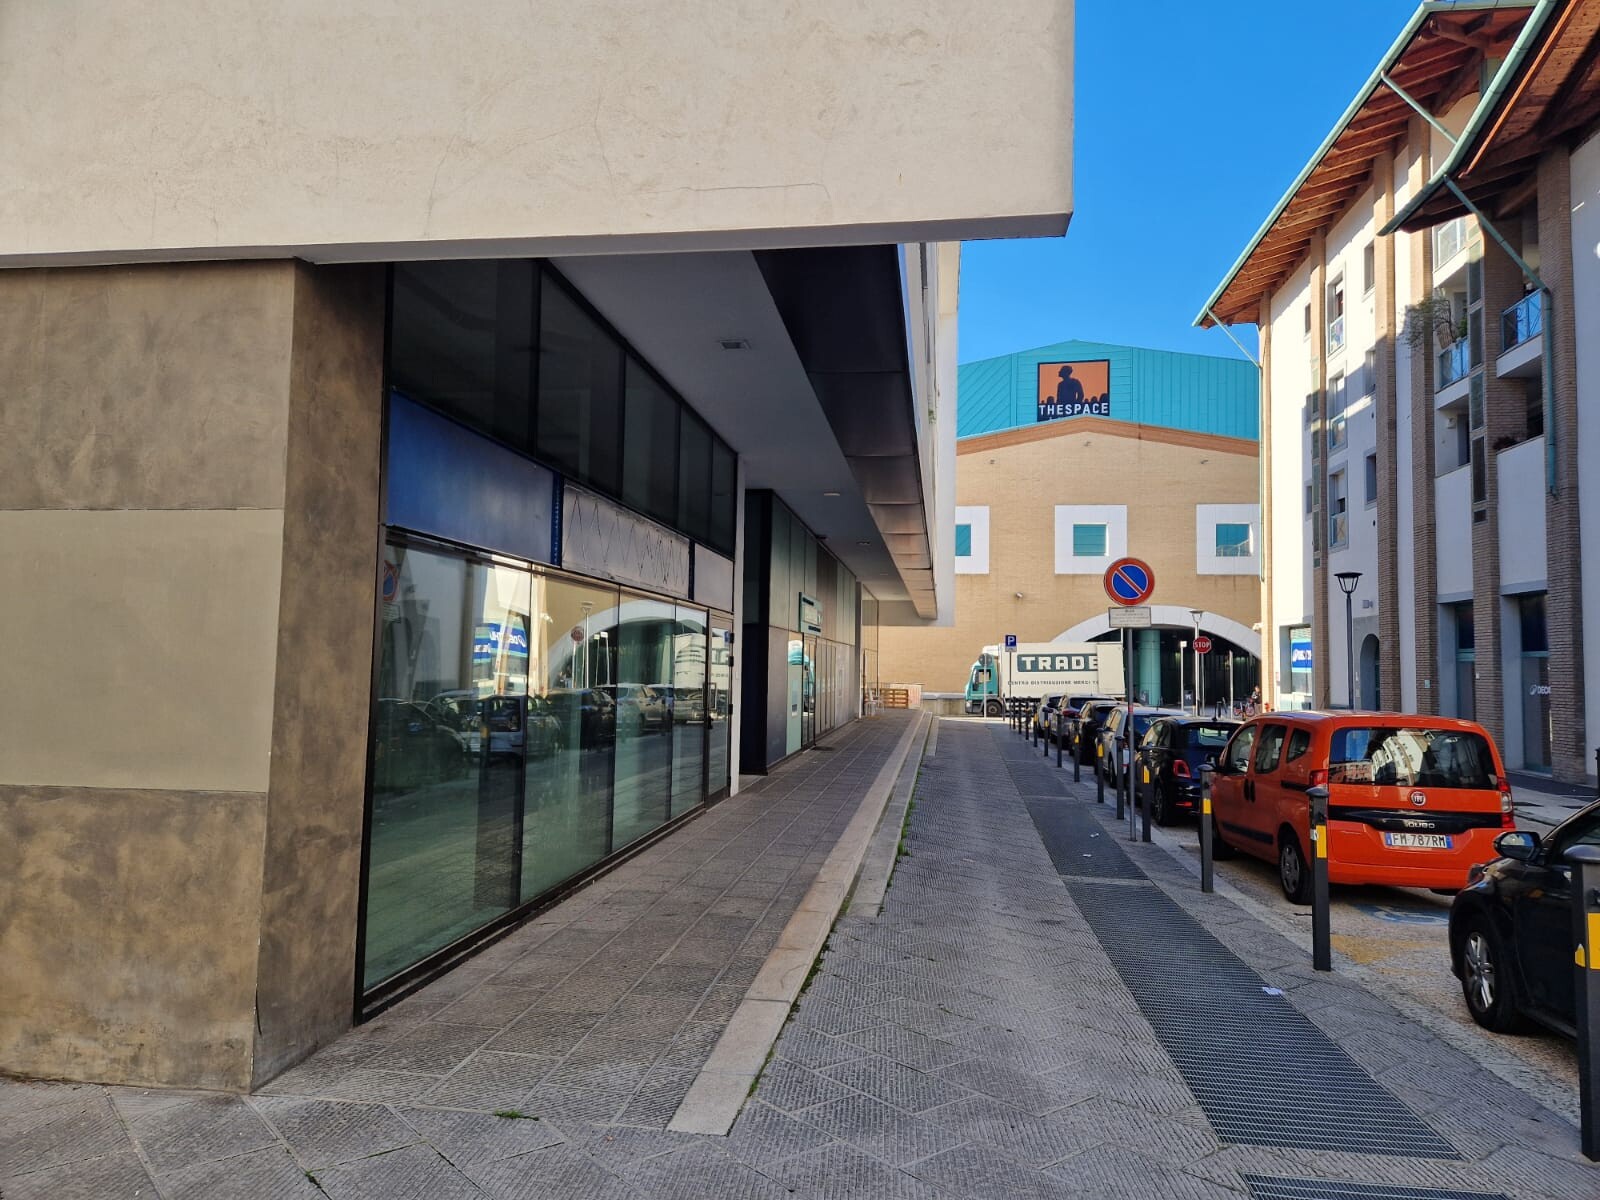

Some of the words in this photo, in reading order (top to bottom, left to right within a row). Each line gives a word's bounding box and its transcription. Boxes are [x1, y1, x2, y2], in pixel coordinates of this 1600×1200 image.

[1007, 635, 1015, 646] P
[1194, 641, 1210, 649] STOP
[1021, 655, 1099, 671] TRADE
